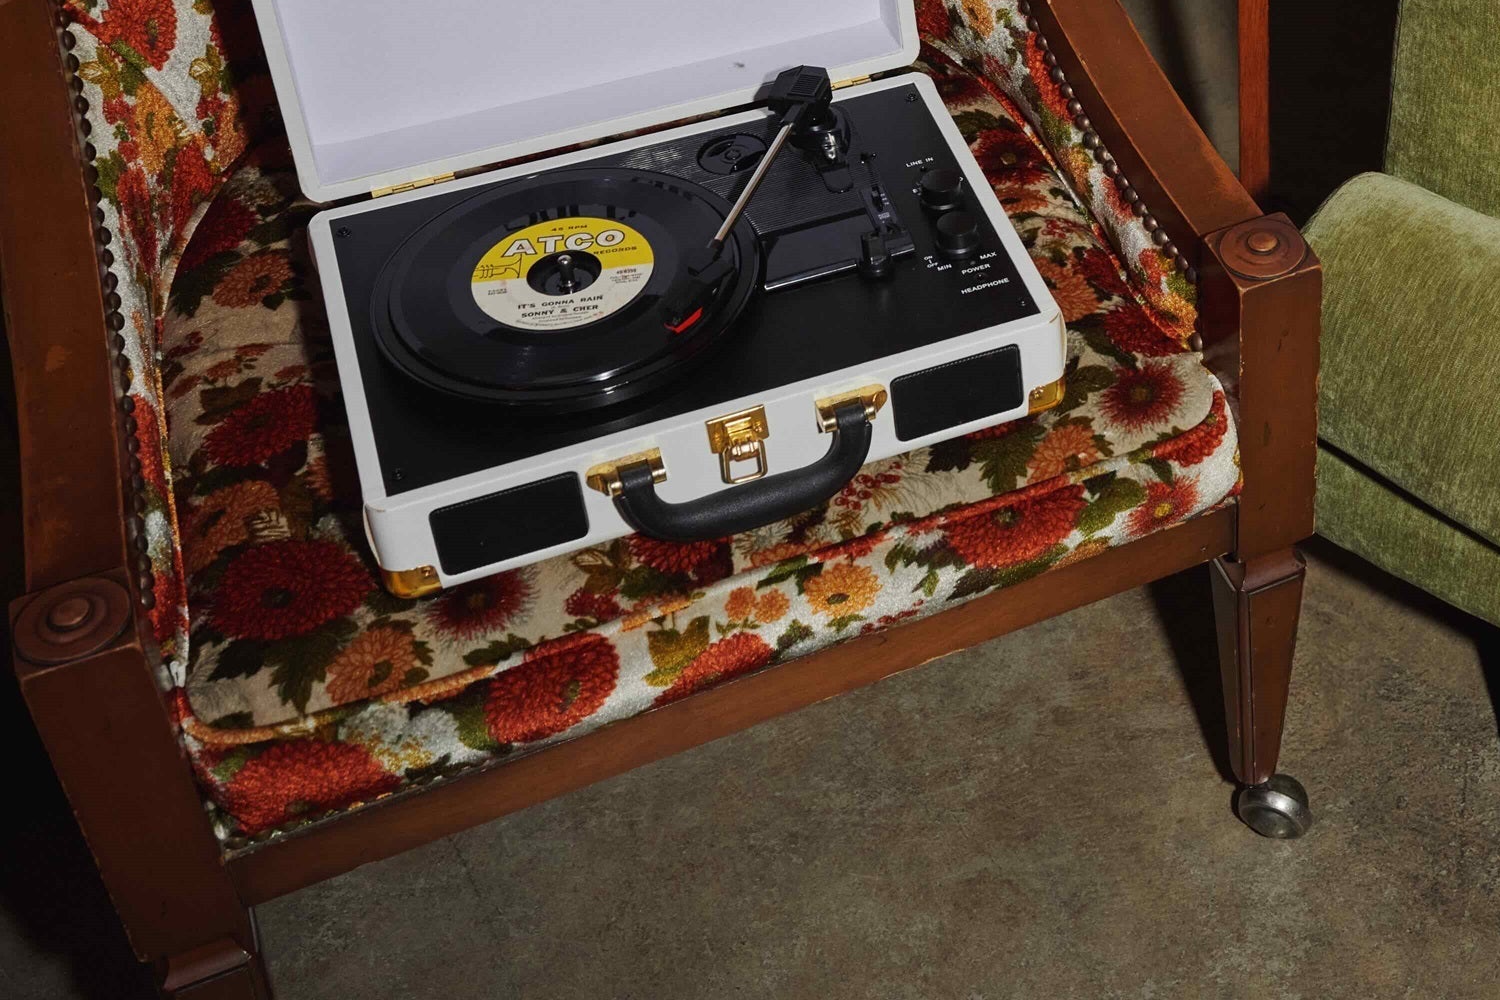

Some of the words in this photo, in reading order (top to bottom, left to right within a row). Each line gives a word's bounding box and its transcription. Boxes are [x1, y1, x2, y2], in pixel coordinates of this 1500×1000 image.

[905, 159, 923, 168] LINE
[501, 229, 625, 258] ATCO
[593, 246, 637, 255] RECORDS
[979, 251, 997, 260] MAX
[937, 263, 953, 272] MIN
[961, 263, 991, 275] POWER
[960, 277, 1010, 295] HEADPHONE
[517, 302, 536, 310] IT'S
[541, 299, 574, 307] GONNA
[521, 309, 554, 318] SONNY
[573, 304, 599, 312] CHER
